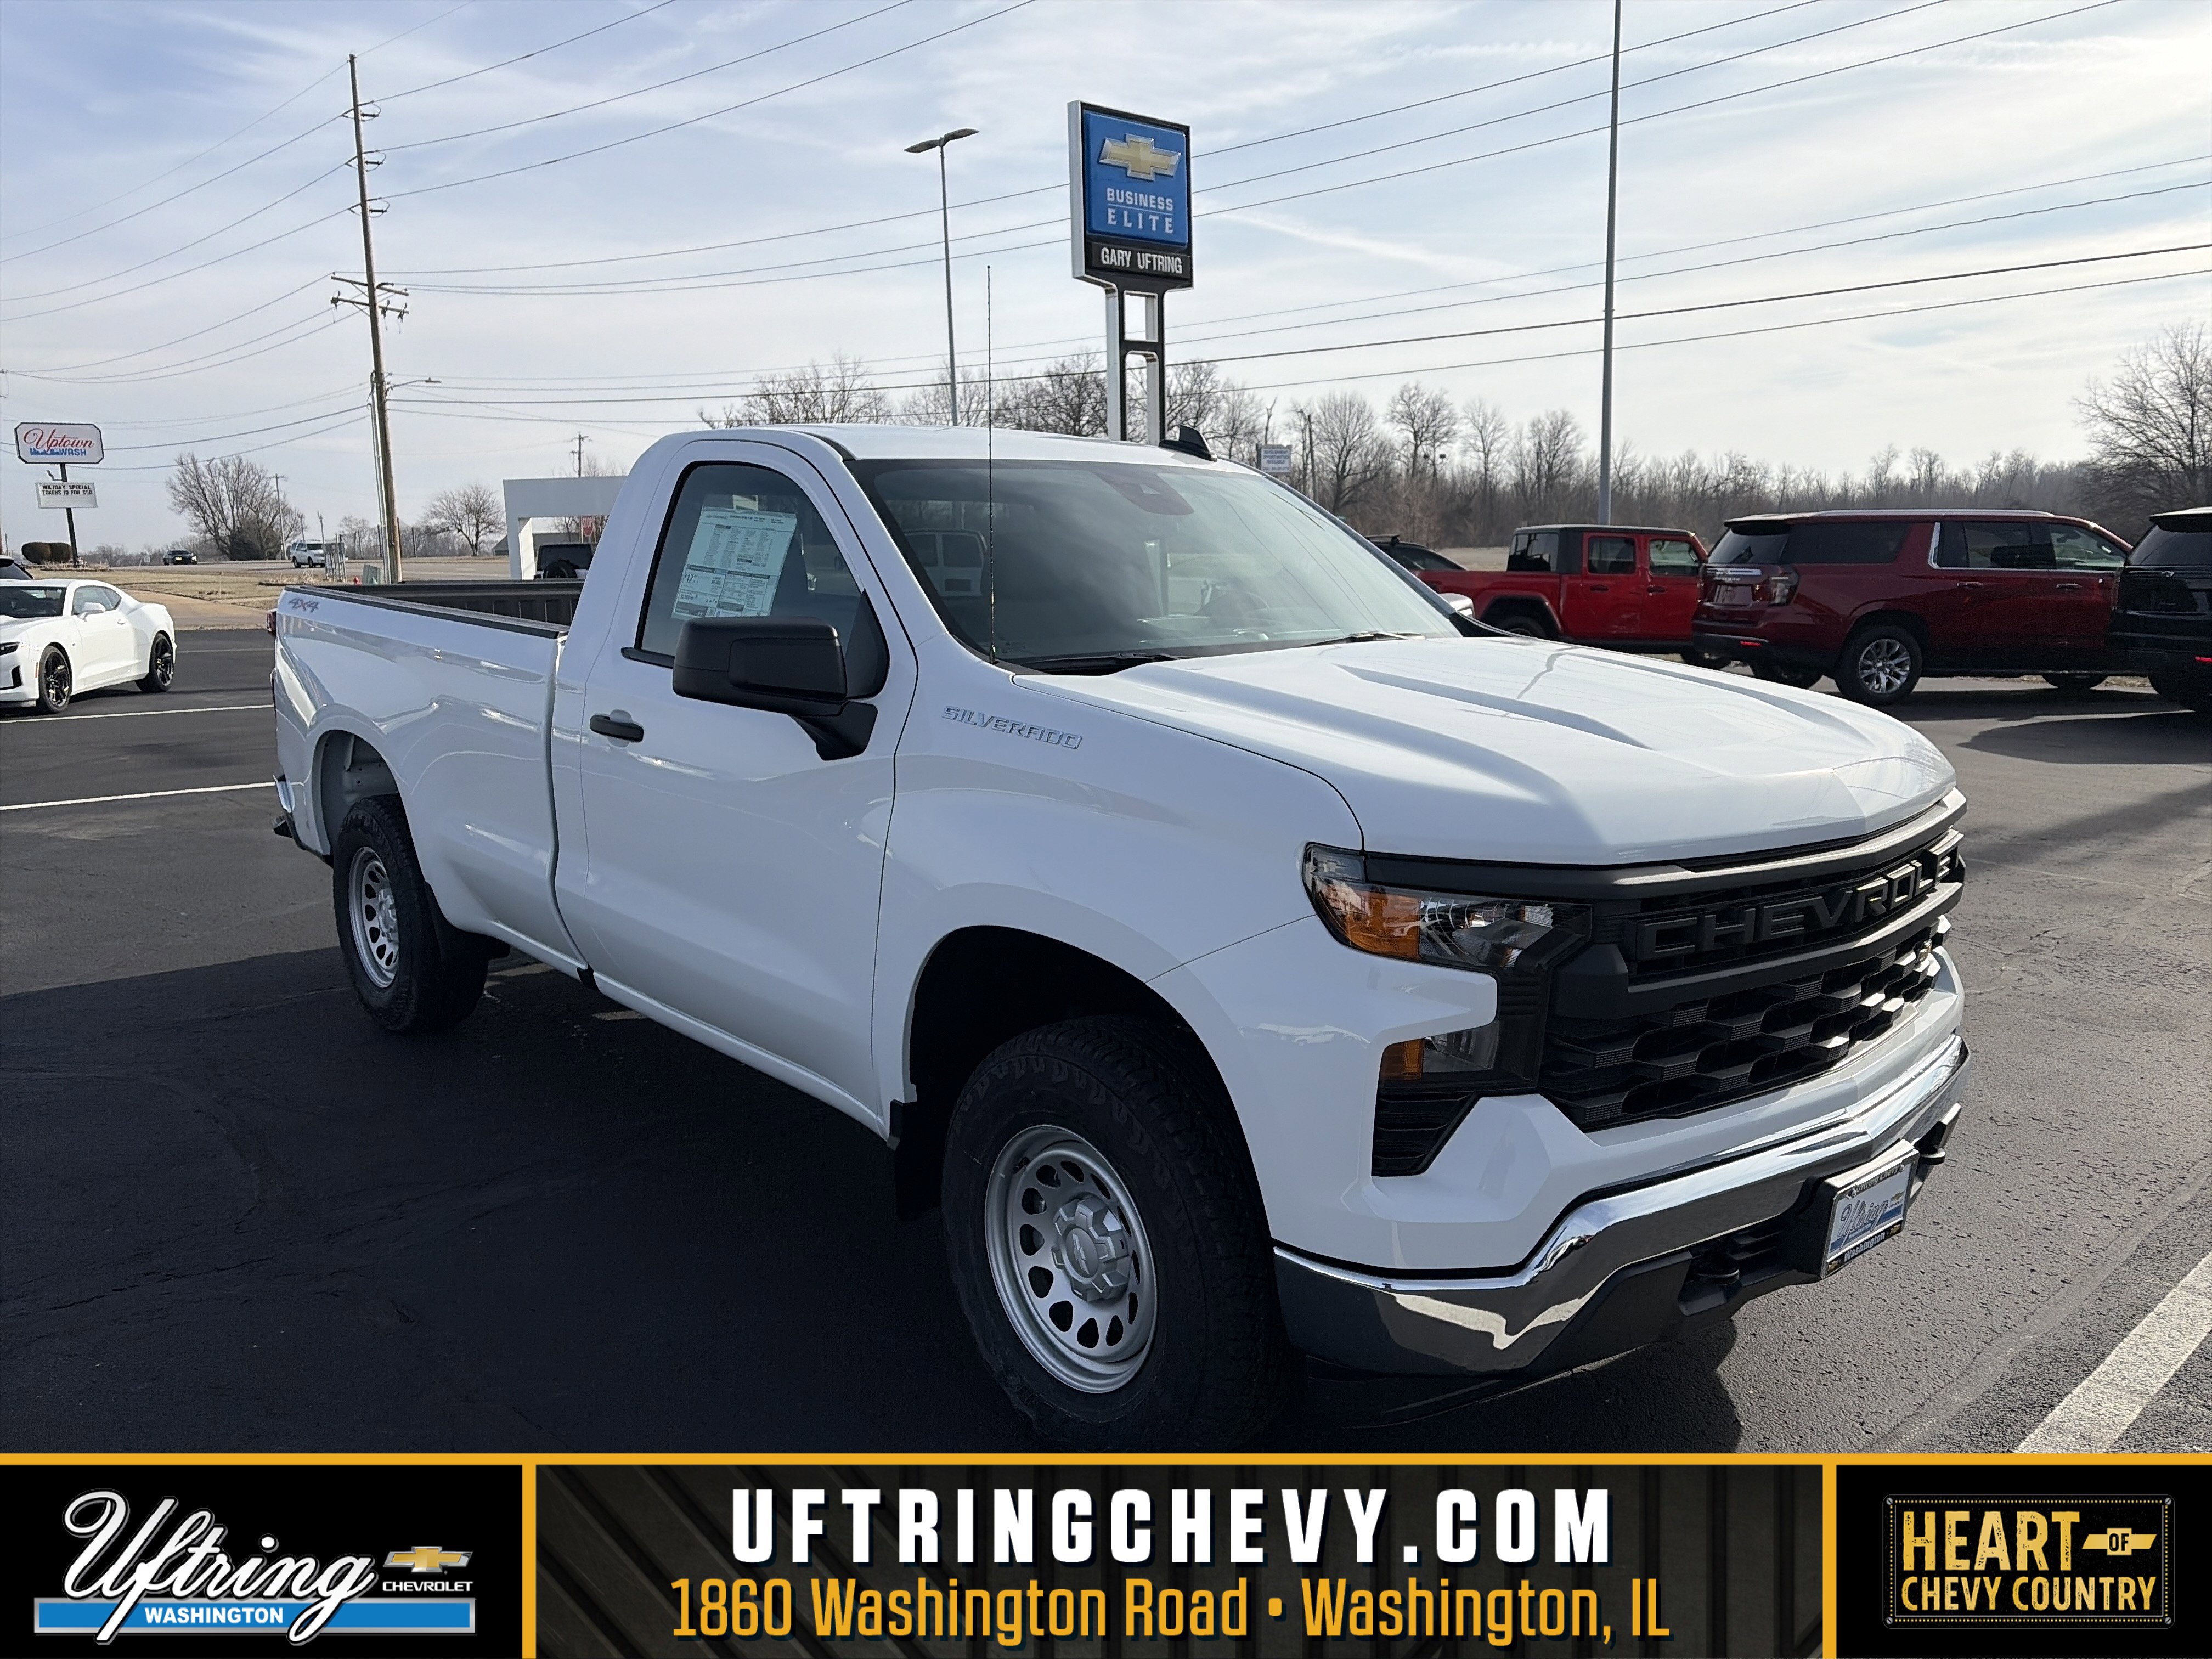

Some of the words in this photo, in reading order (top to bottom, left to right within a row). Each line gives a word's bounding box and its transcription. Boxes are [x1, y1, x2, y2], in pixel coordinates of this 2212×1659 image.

[1107, 187, 1173, 211] BUSINESS
[1107, 208, 1173, 234] ELITE
[1101, 247, 1132, 268] GARY
[1137, 252, 1183, 274] UFTRING
[23, 428, 94, 452] Uptown
[59, 448, 87, 456] WASH
[941, 705, 1083, 749] SILVERADO
[1843, 1232, 1886, 1262] Washington
